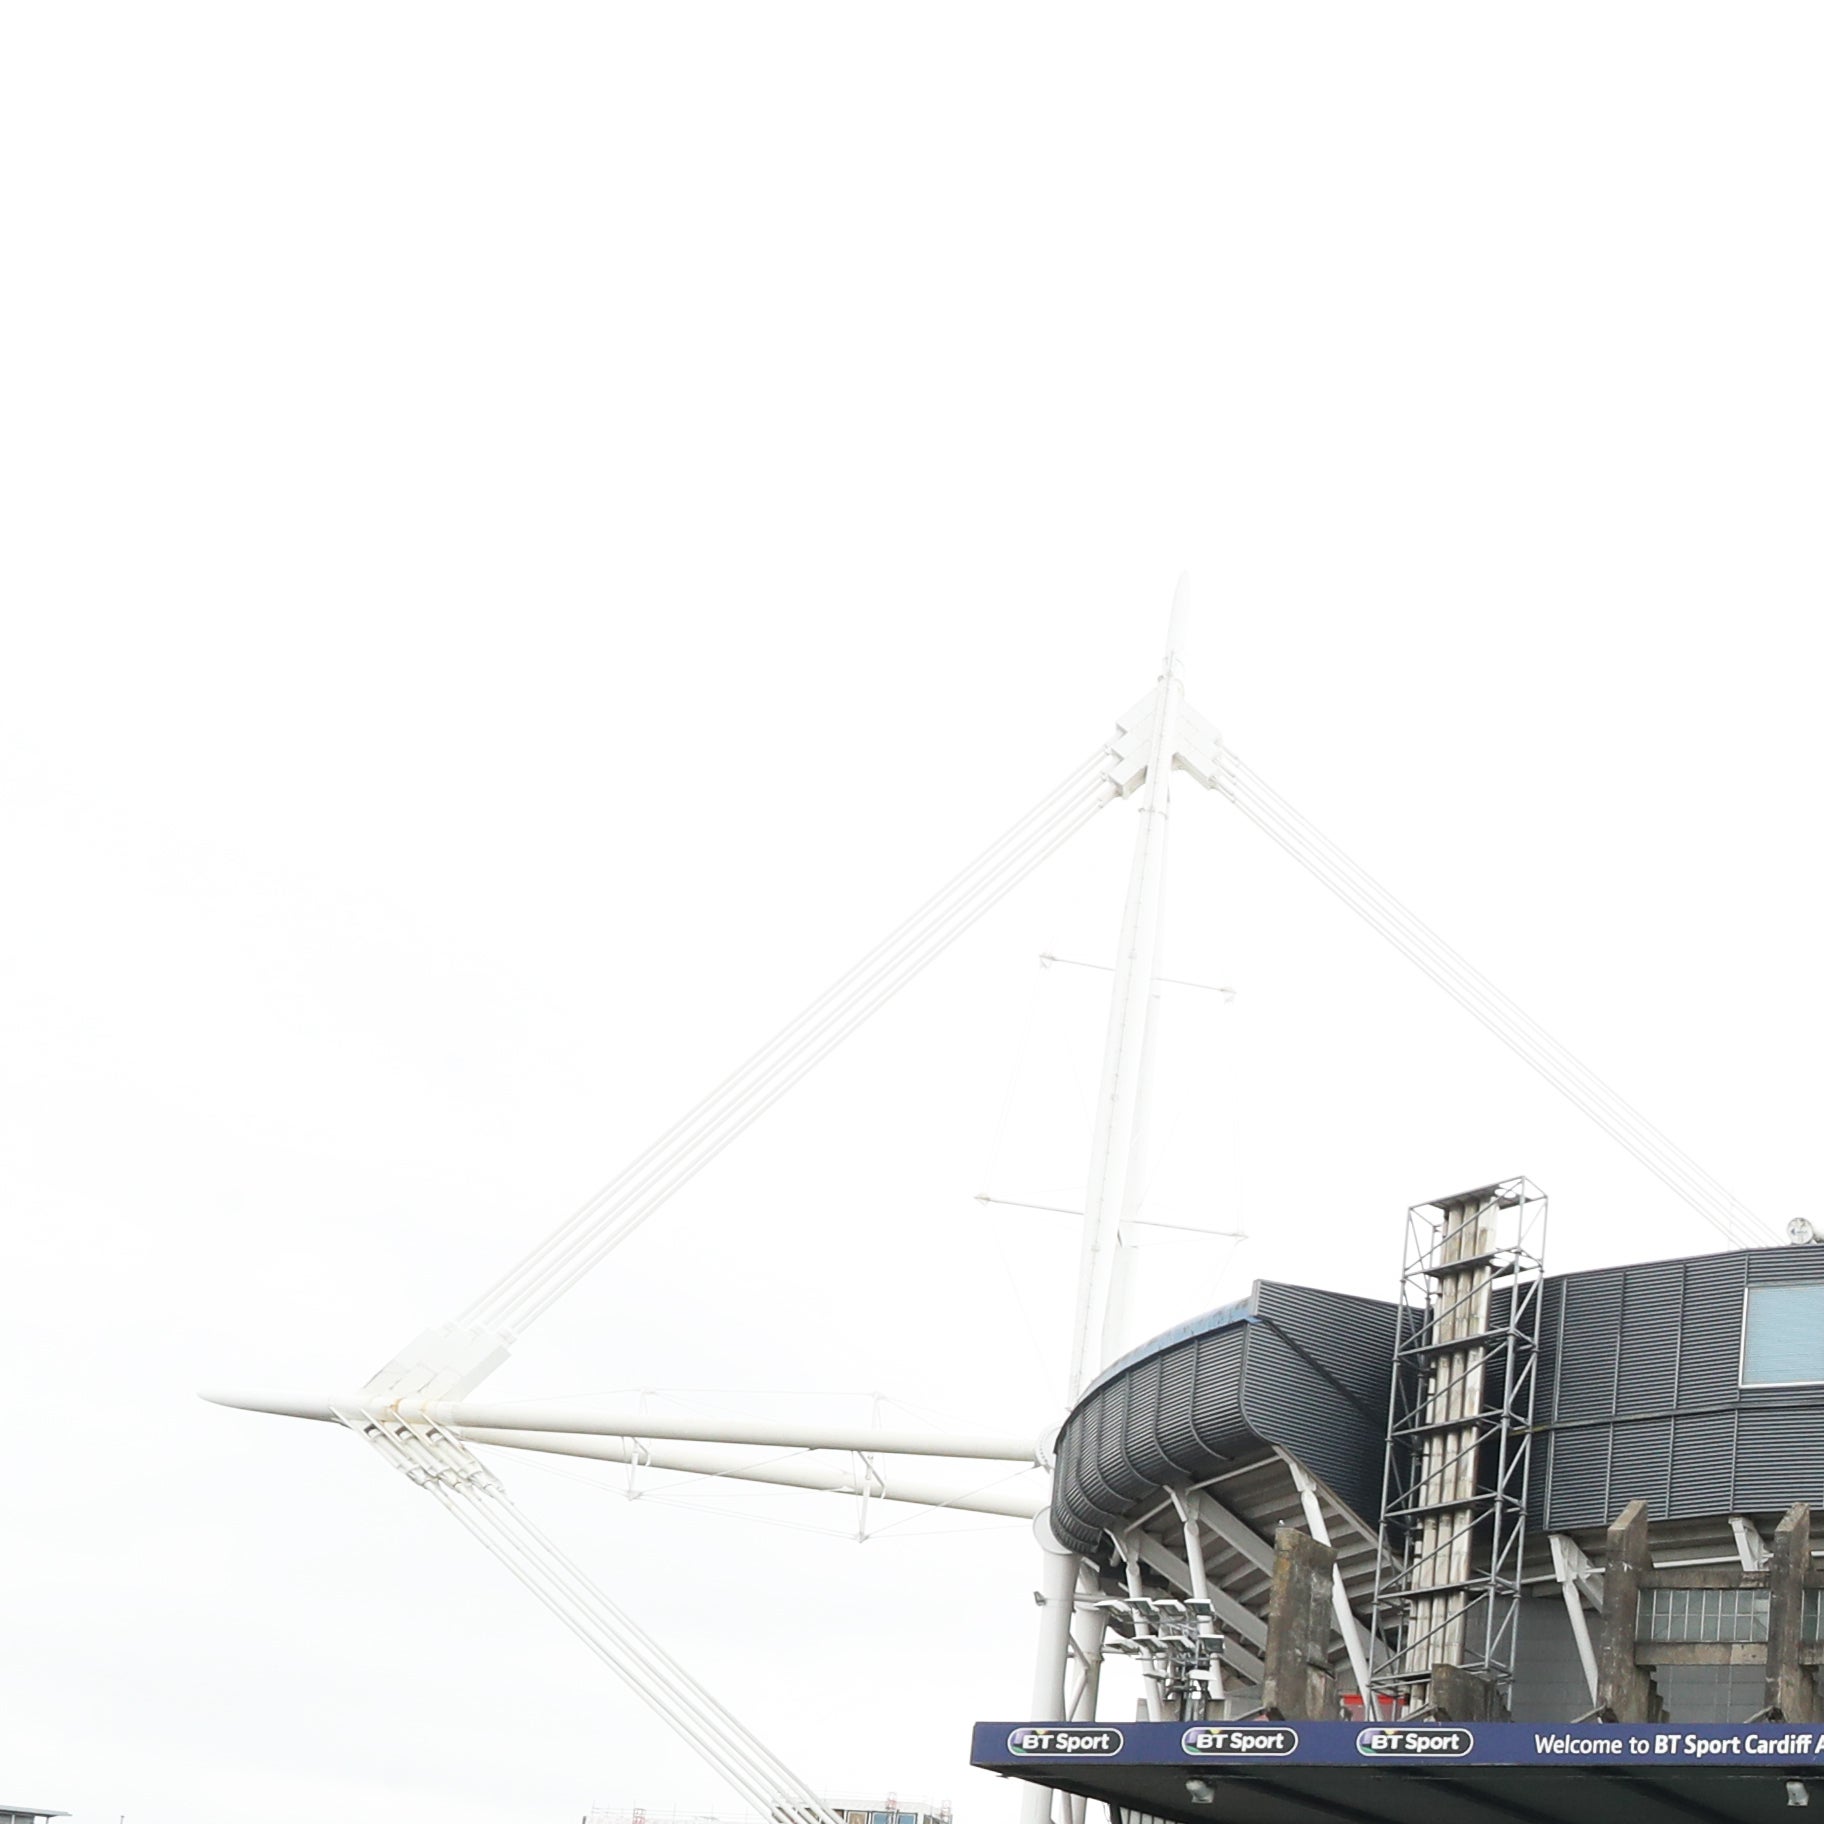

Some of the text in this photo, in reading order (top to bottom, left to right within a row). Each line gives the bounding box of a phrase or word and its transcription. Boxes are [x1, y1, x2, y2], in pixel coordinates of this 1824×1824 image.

[1022, 1733, 1110, 1752] BT Sport
[1196, 1732, 1285, 1752] BT Sport
[1370, 1732, 1460, 1752] BT Sport
[1535, 1734, 1622, 1754] Welcome
[1629, 1737, 1650, 1754] to
[1654, 1735, 1682, 1754] BT
[1684, 1734, 1741, 1757] Sport
[1744, 1734, 1813, 1754] Cardiff
